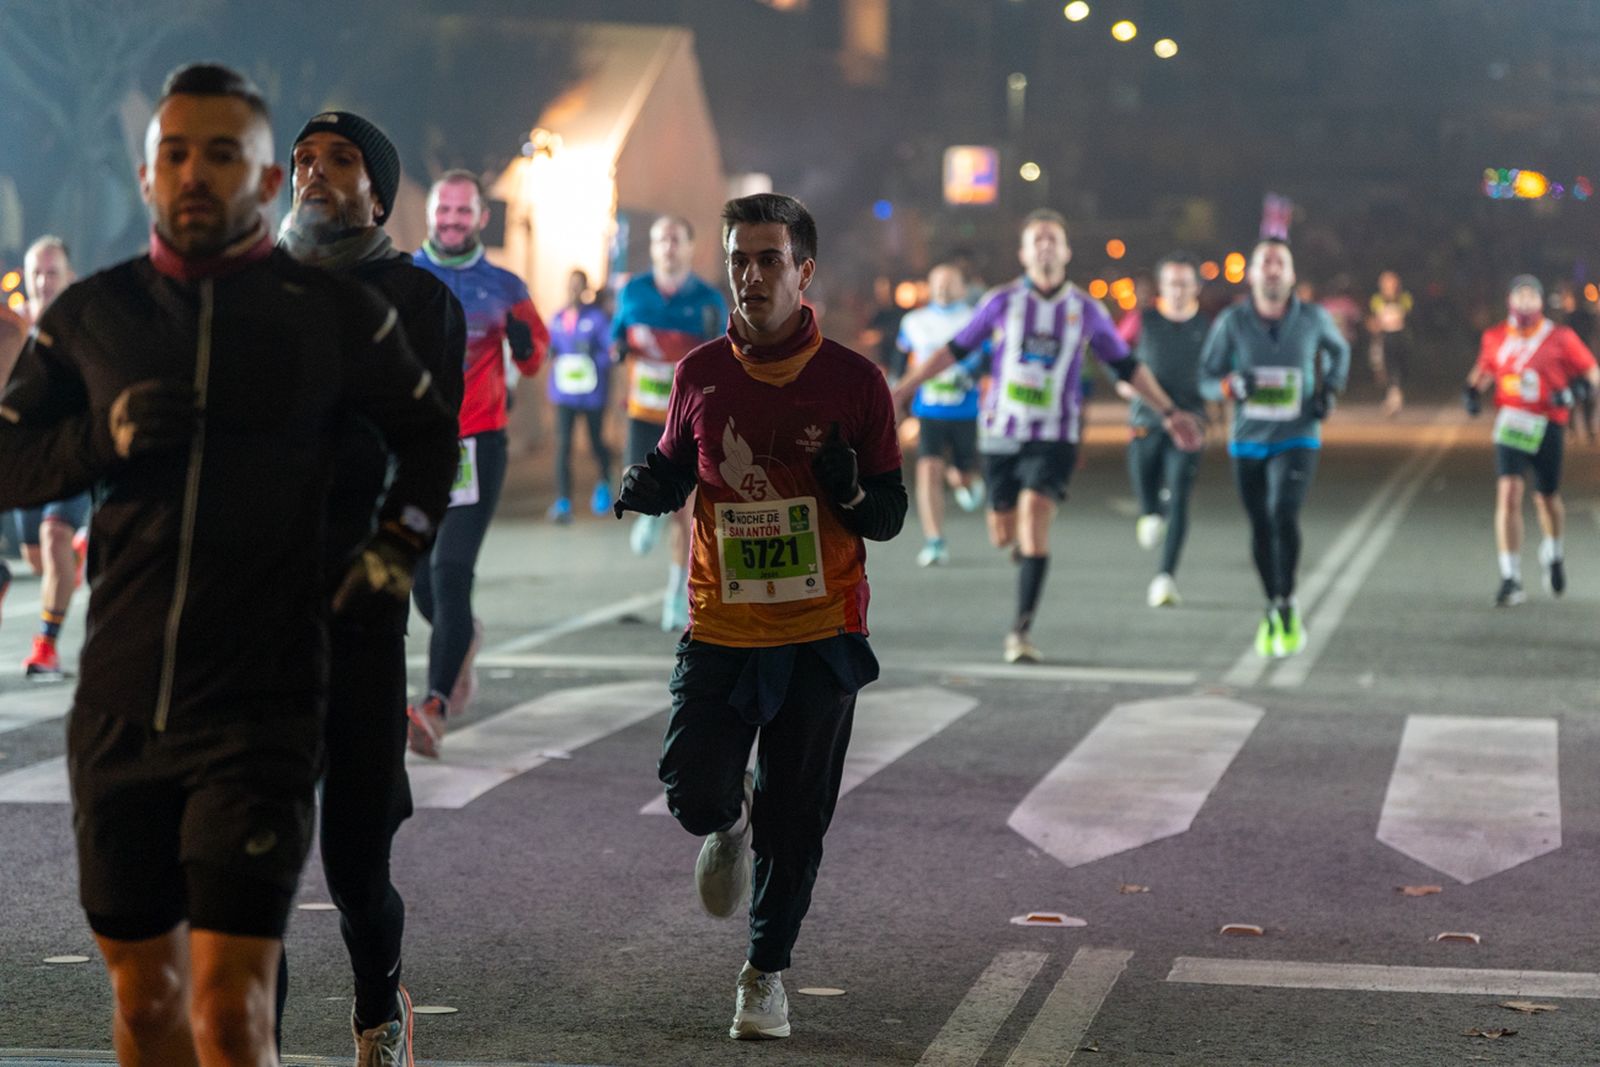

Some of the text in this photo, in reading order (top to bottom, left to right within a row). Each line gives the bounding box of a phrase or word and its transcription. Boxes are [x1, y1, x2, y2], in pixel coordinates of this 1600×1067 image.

[740, 473, 767, 501] 43
[736, 512, 780, 525] NOCHE DE
[729, 526, 744, 537] SAN
[746, 523, 781, 537] ANTÓN
[741, 536, 800, 570] 5721
